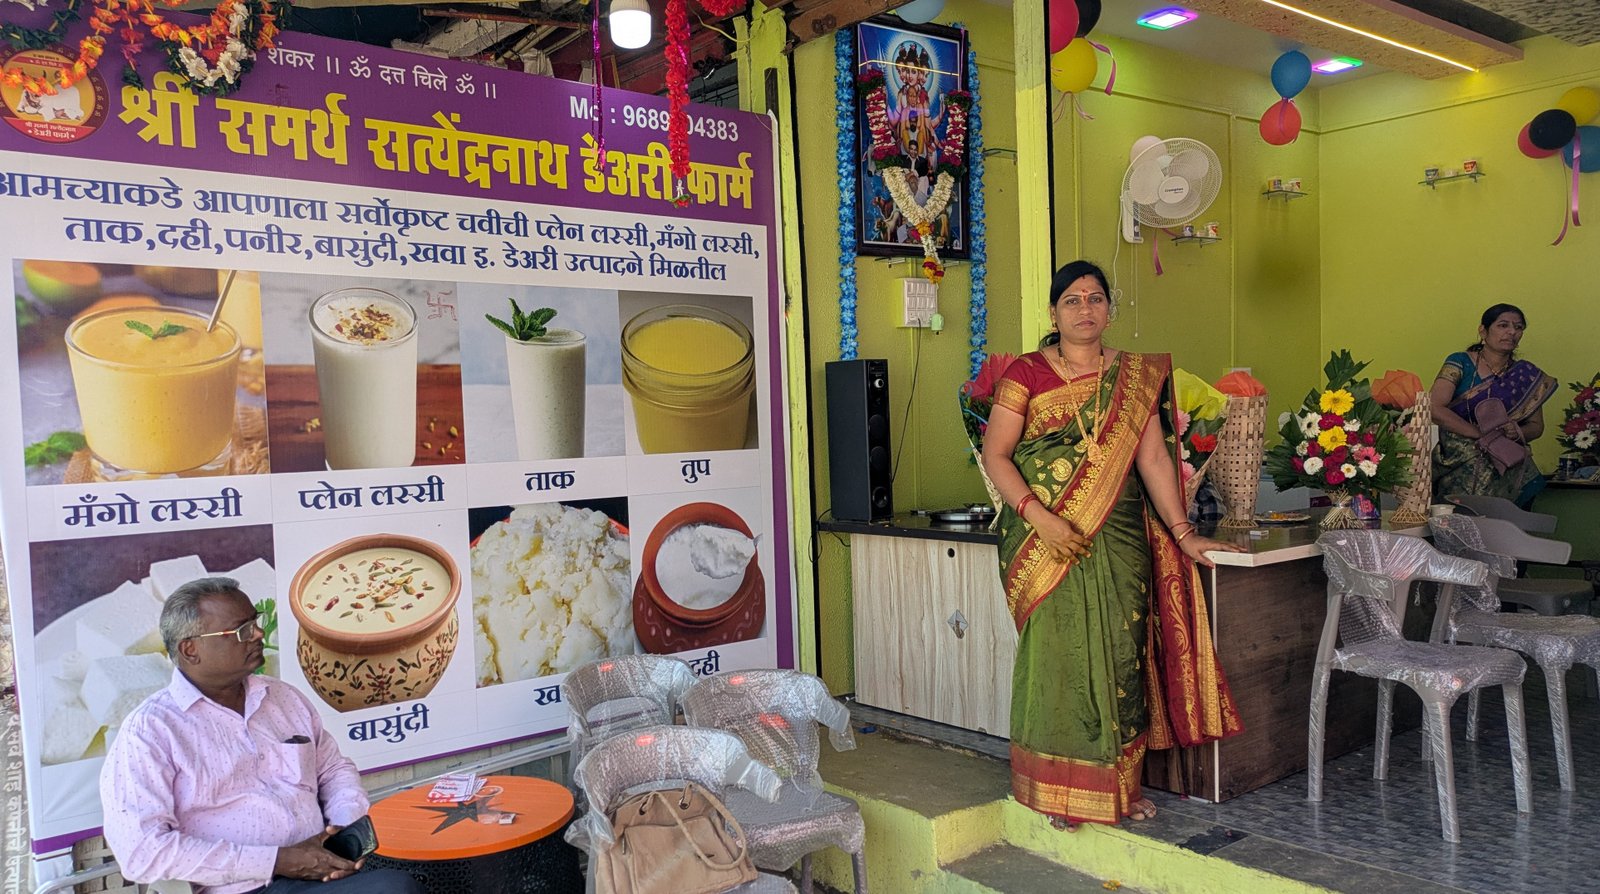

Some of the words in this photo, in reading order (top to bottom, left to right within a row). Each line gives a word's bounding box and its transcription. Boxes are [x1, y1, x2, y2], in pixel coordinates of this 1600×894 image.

[267, 41, 316, 71] शंकर
[349, 55, 371, 79] ॐ
[378, 64, 406, 85] दत्त
[411, 64, 448, 91] चिले
[455, 72, 475, 95] ॐ
[118, 71, 199, 148] श्री
[215, 92, 351, 165] समर्थ
[364, 110, 570, 189] सत्येंद्रनाथ
[579, 132, 674, 201] डेअरी
[686, 152, 754, 209] फार्म
[623, 104, 740, 142] 968904383
[0, 172, 183, 209] आमच्याकडे
[193, 188, 328, 222] आपणाला
[456, 208, 528, 238] चवीची
[535, 212, 584, 242] प्लेन
[702, 232, 760, 259] लस्सी,
[503, 241, 558, 272] डेअरी
[564, 250, 643, 277] उत्पादने
[648, 253, 727, 282] मिळतील
[524, 470, 575, 492] ताक
[681, 459, 711, 483] तुप
[62, 493, 140, 528] मँगो
[149, 487, 243, 523] लस्सी
[297, 480, 362, 510] प्लेन
[370, 475, 446, 505] लस्सी
[346, 702, 430, 744] बासुंदी
